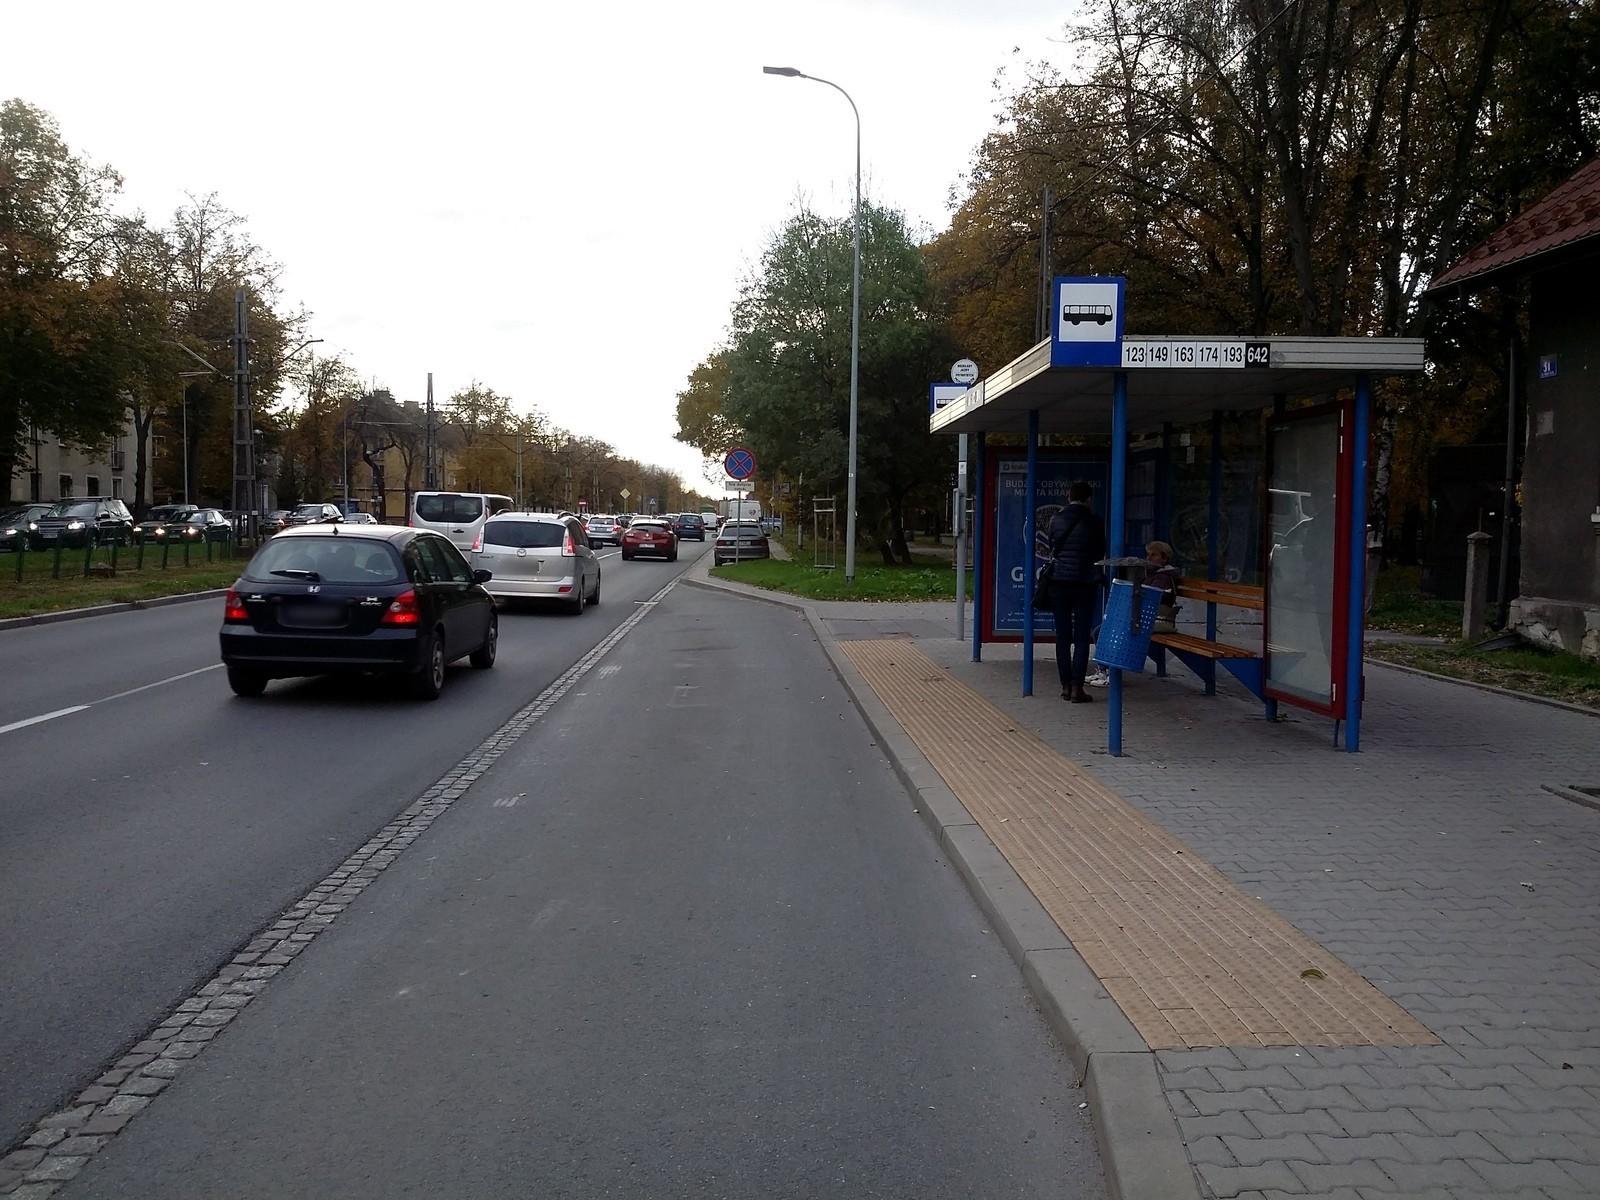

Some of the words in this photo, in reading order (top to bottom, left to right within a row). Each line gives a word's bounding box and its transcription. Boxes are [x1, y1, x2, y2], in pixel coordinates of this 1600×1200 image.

[1126, 347, 1145, 362] 123
[1149, 347, 1168, 362] 149
[1174, 347, 1194, 362] 163
[1199, 347, 1218, 362] 174
[1223, 347, 1242, 362] 193
[1247, 347, 1268, 363] 642
[1543, 361, 1551, 373] 31
